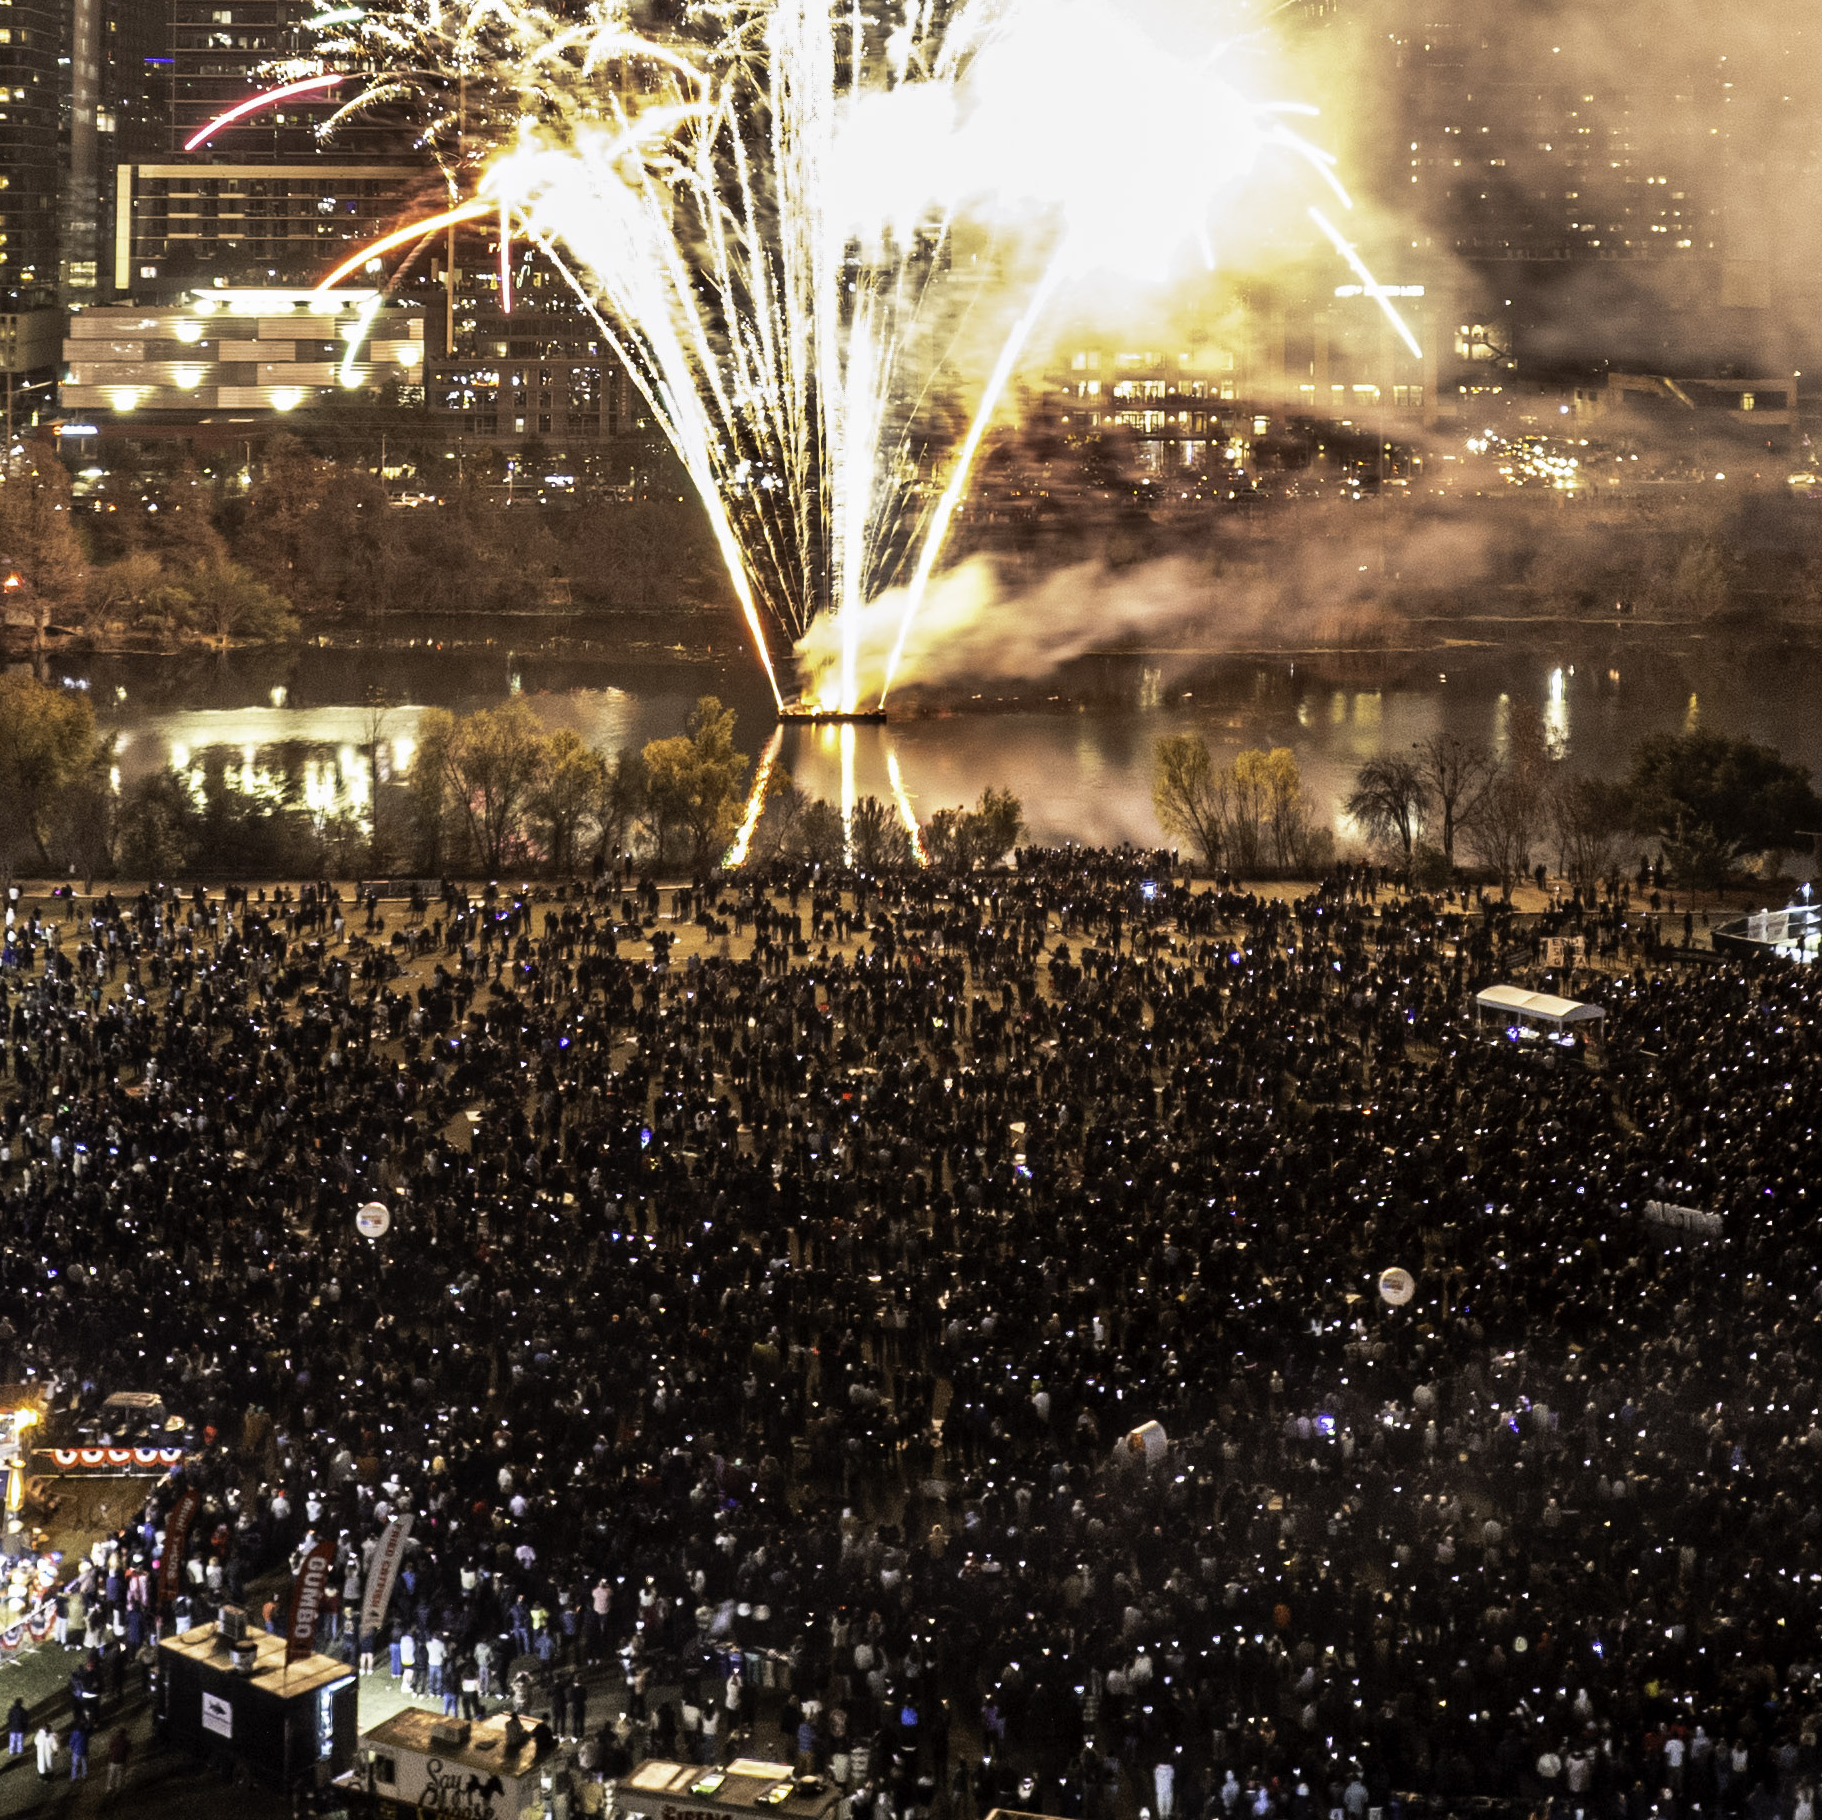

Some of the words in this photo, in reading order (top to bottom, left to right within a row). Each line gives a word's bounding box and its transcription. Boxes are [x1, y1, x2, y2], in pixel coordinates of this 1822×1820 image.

[385, 1523, 403, 1557] FRIED
[294, 1555, 327, 1639] GUMBO
[426, 1757, 469, 1796] Say
